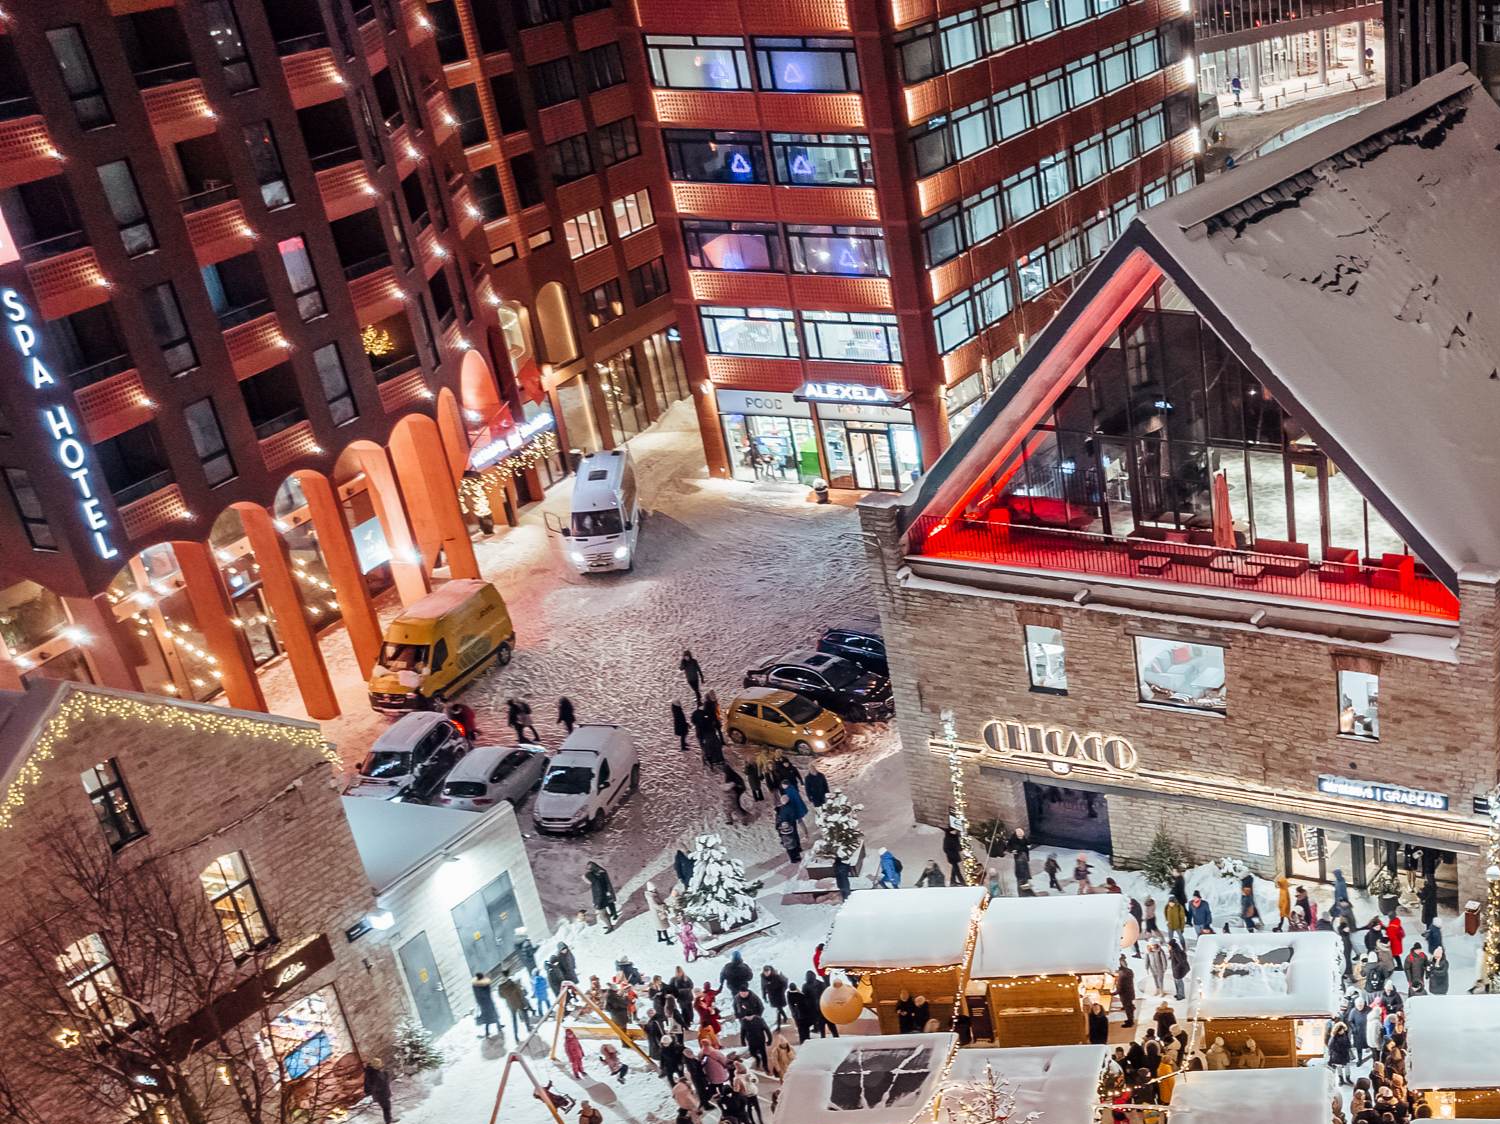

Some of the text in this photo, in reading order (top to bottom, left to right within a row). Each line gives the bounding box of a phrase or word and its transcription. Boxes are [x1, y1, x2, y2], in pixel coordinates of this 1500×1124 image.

[804, 383, 888, 402] ALEXELA
[3, 289, 119, 560] SPA HOTEL
[982, 719, 1138, 770] CHICAGO
